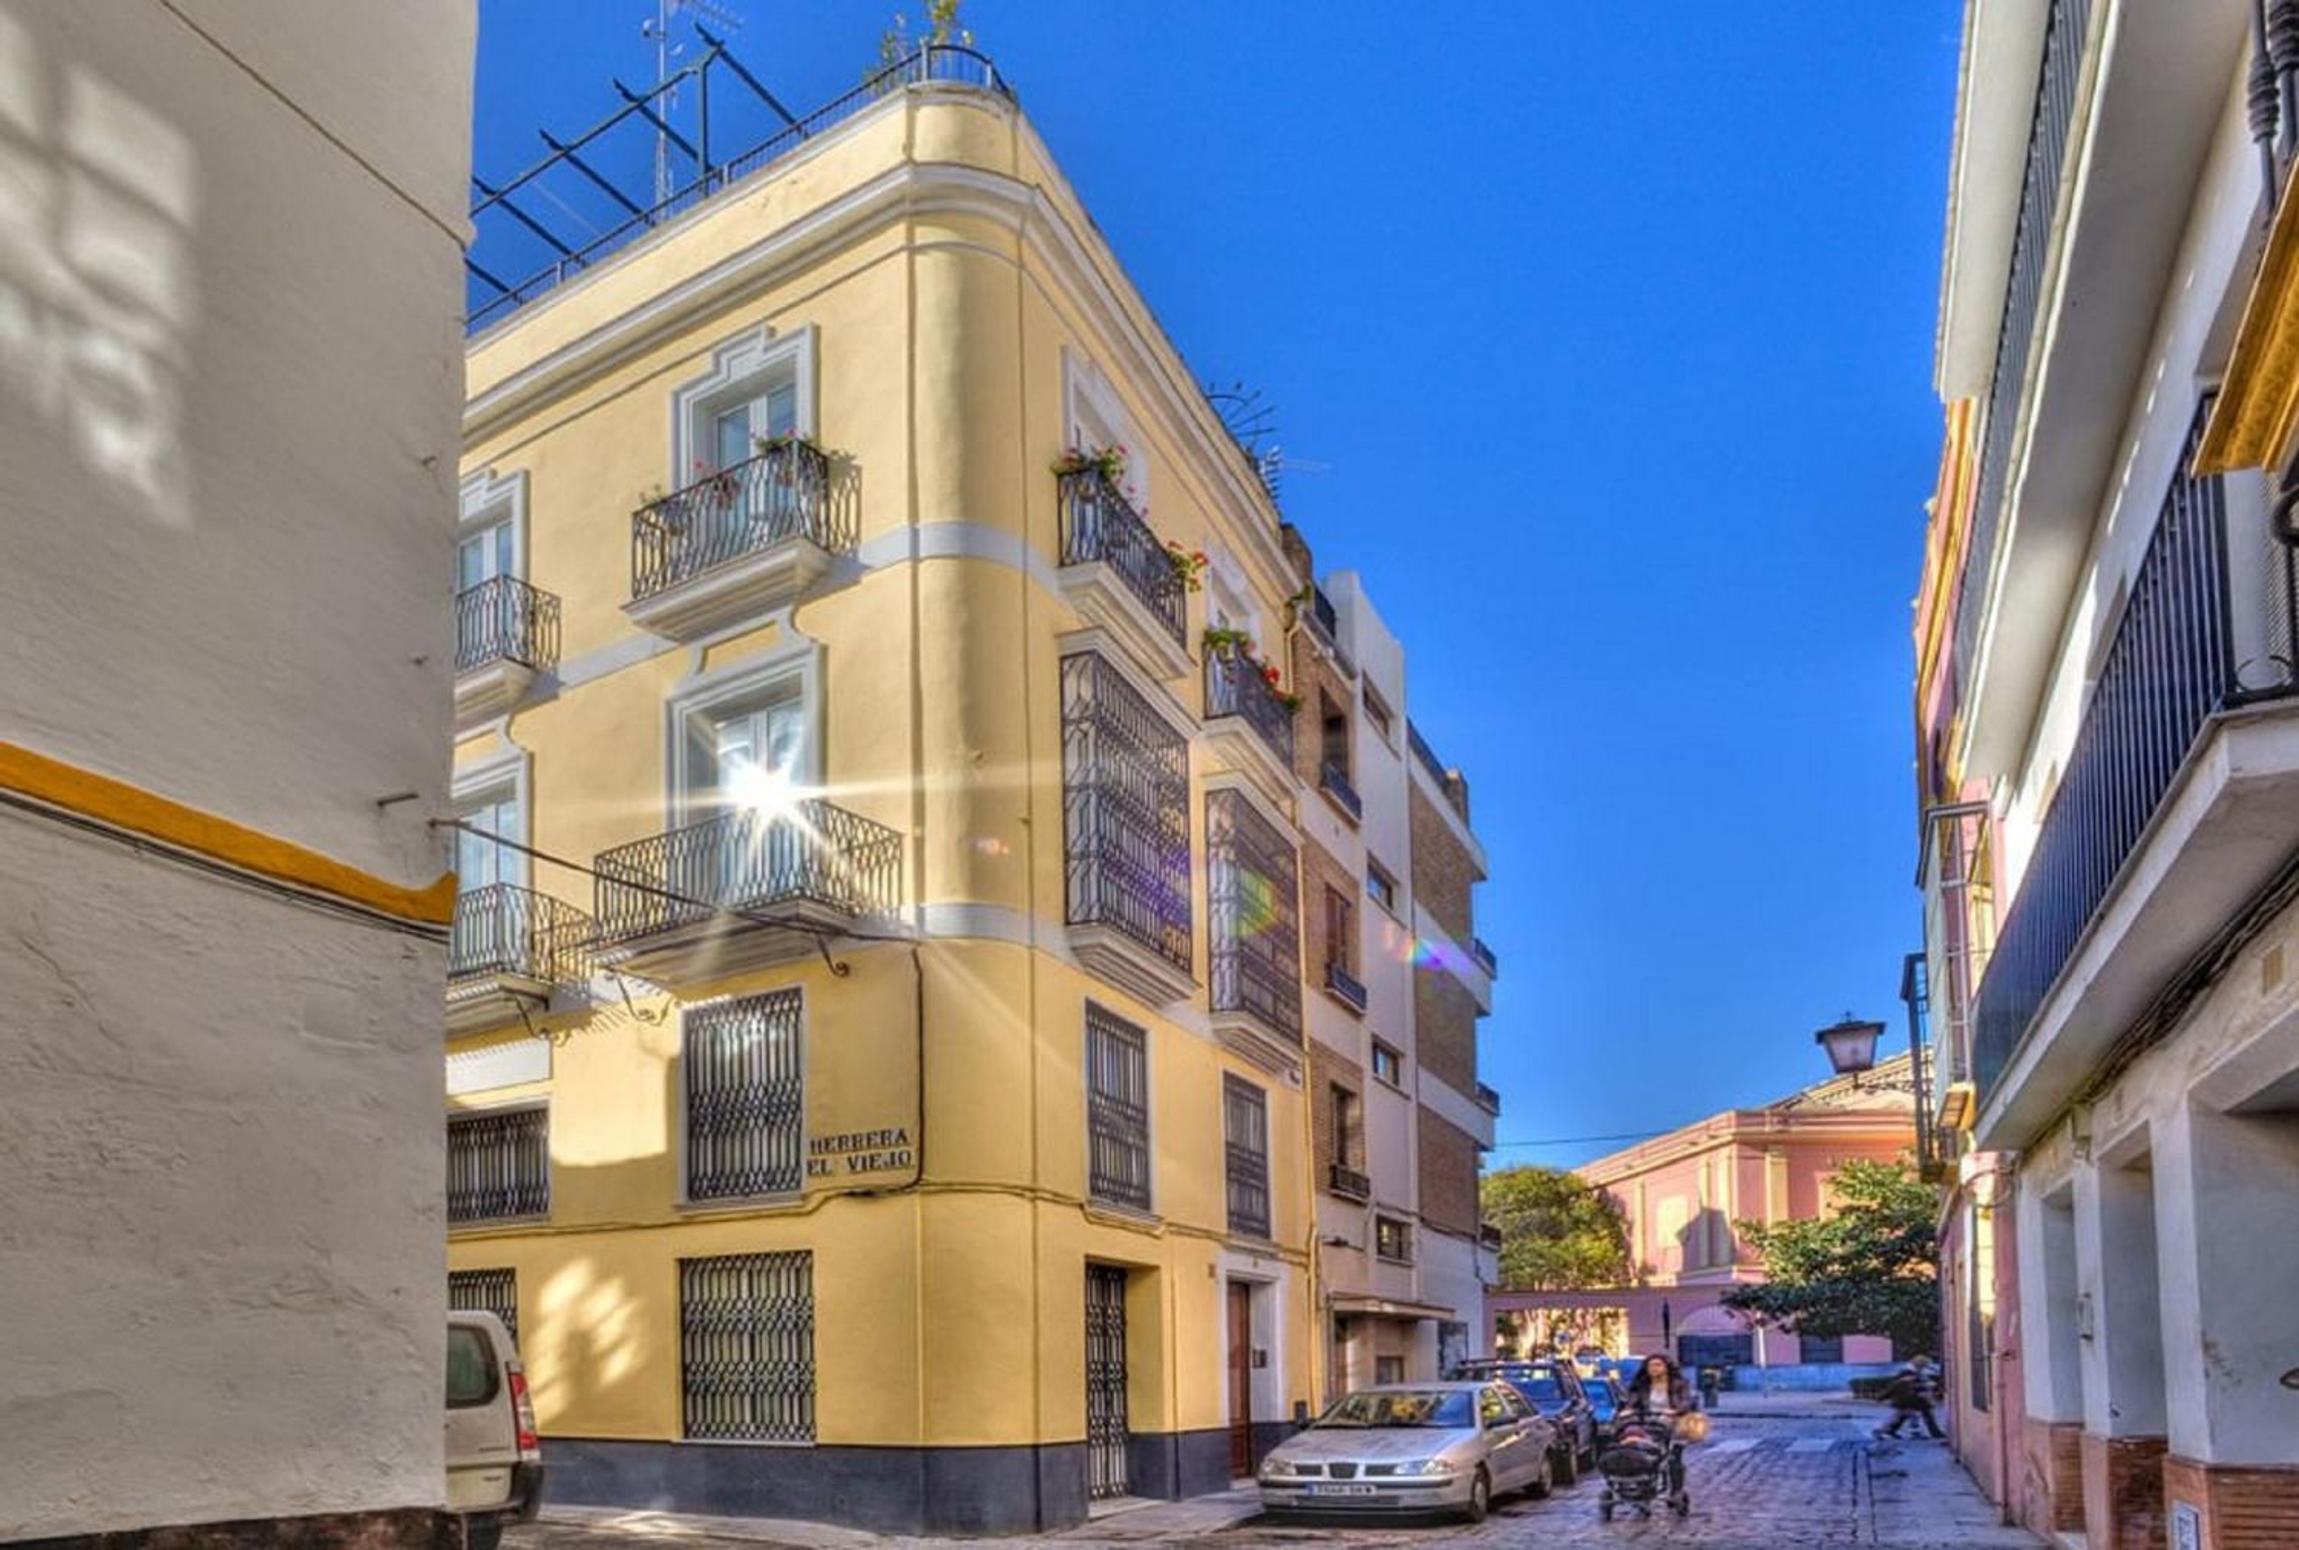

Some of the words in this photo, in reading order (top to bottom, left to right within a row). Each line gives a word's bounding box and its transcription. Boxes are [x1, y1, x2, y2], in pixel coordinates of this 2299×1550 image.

[810, 1128, 909, 1156] HERRERA
[807, 1158, 832, 1176] EL
[847, 1150, 912, 1172] VIEJO
